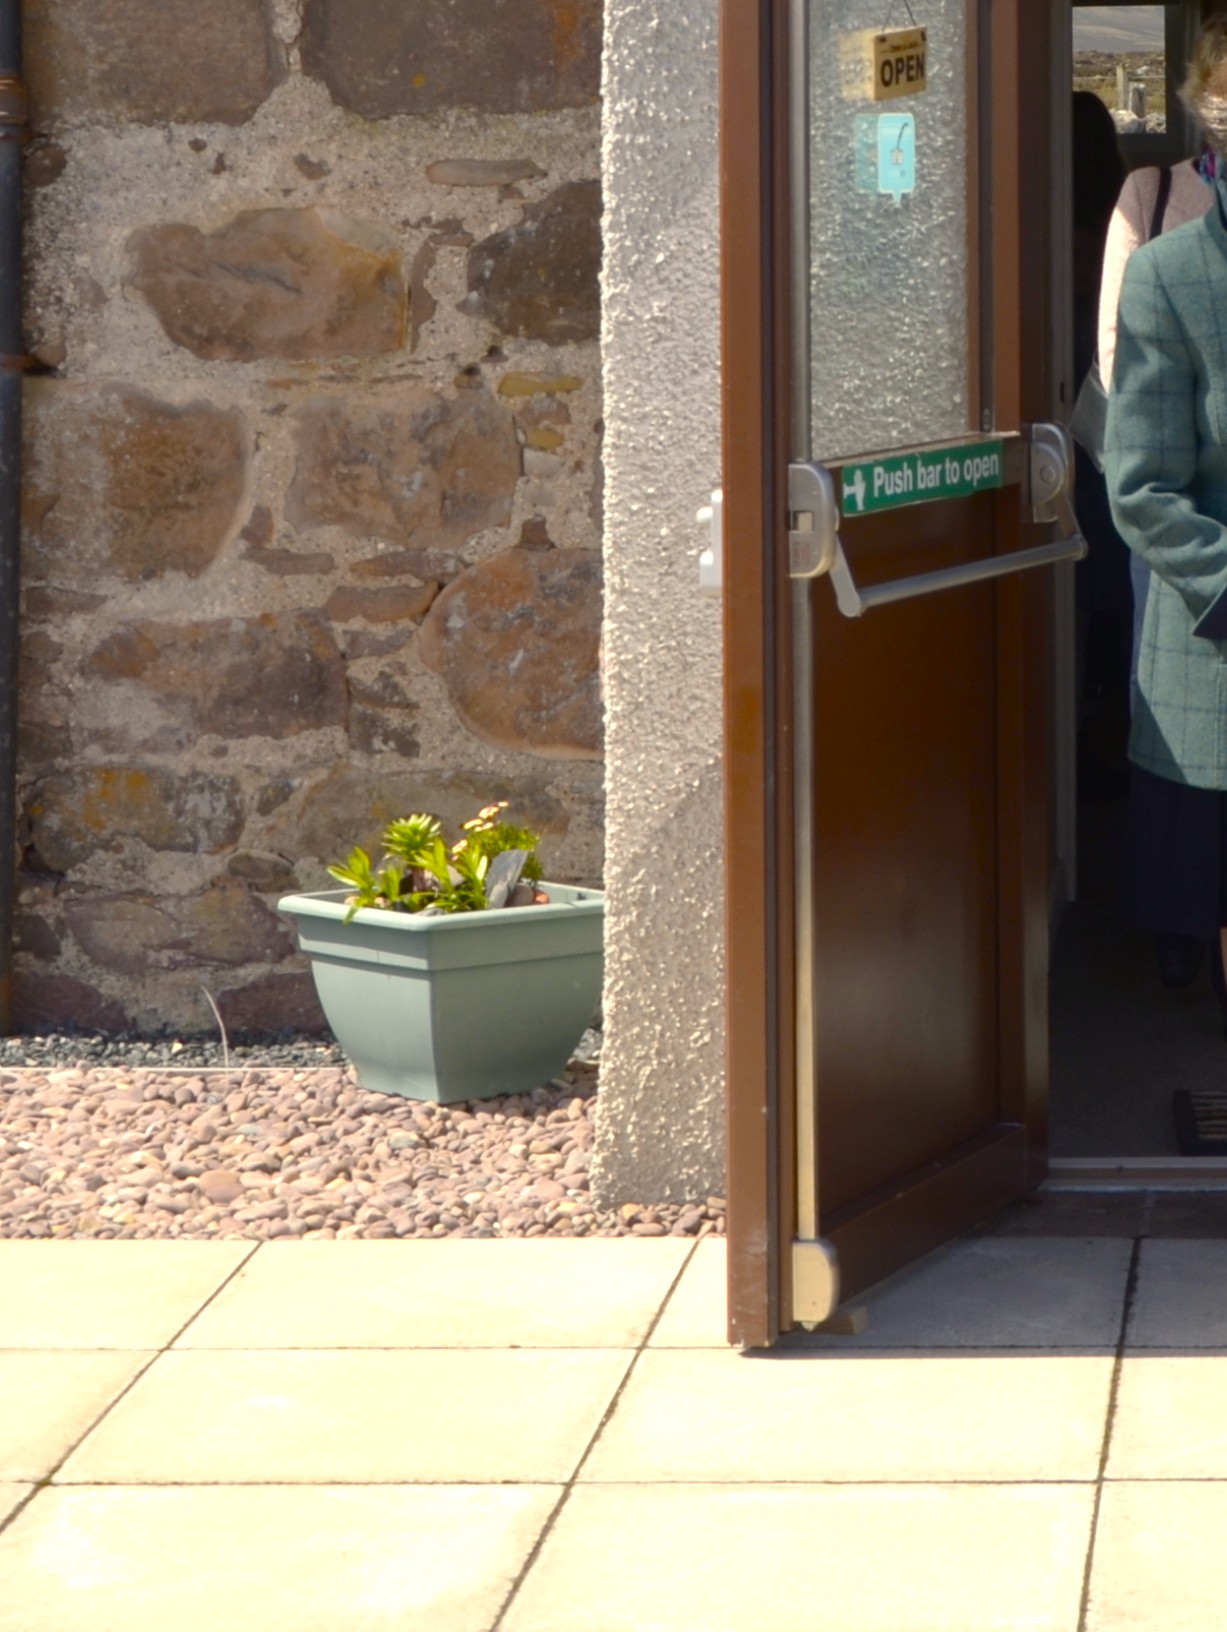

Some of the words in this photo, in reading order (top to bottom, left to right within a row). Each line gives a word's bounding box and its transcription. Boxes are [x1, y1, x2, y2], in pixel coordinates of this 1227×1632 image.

[881, 52, 925, 87] OPEN
[873, 461, 913, 497] Push
[917, 459, 942, 489] bar
[945, 457, 960, 484] to
[964, 453, 1000, 487] open
